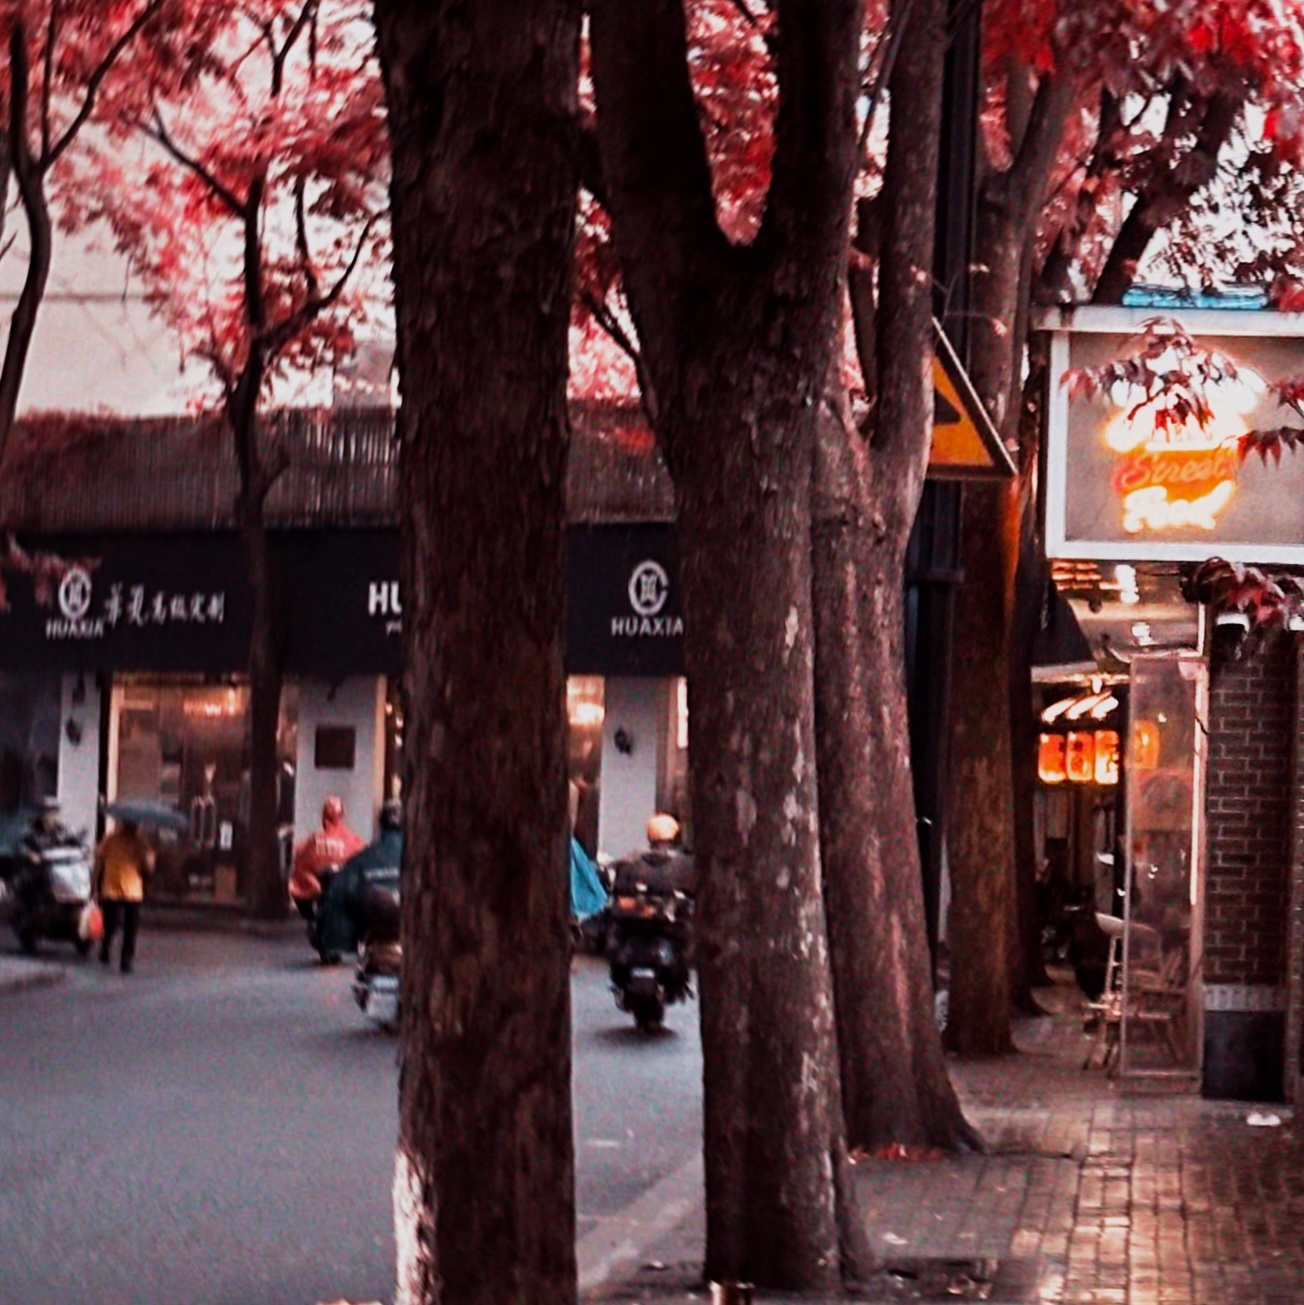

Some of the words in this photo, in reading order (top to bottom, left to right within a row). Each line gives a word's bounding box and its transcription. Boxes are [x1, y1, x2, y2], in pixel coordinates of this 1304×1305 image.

[1121, 453, 1227, 489] Street
[46, 617, 104, 640] HUAXIA
[611, 616, 684, 637] HUAXIA
